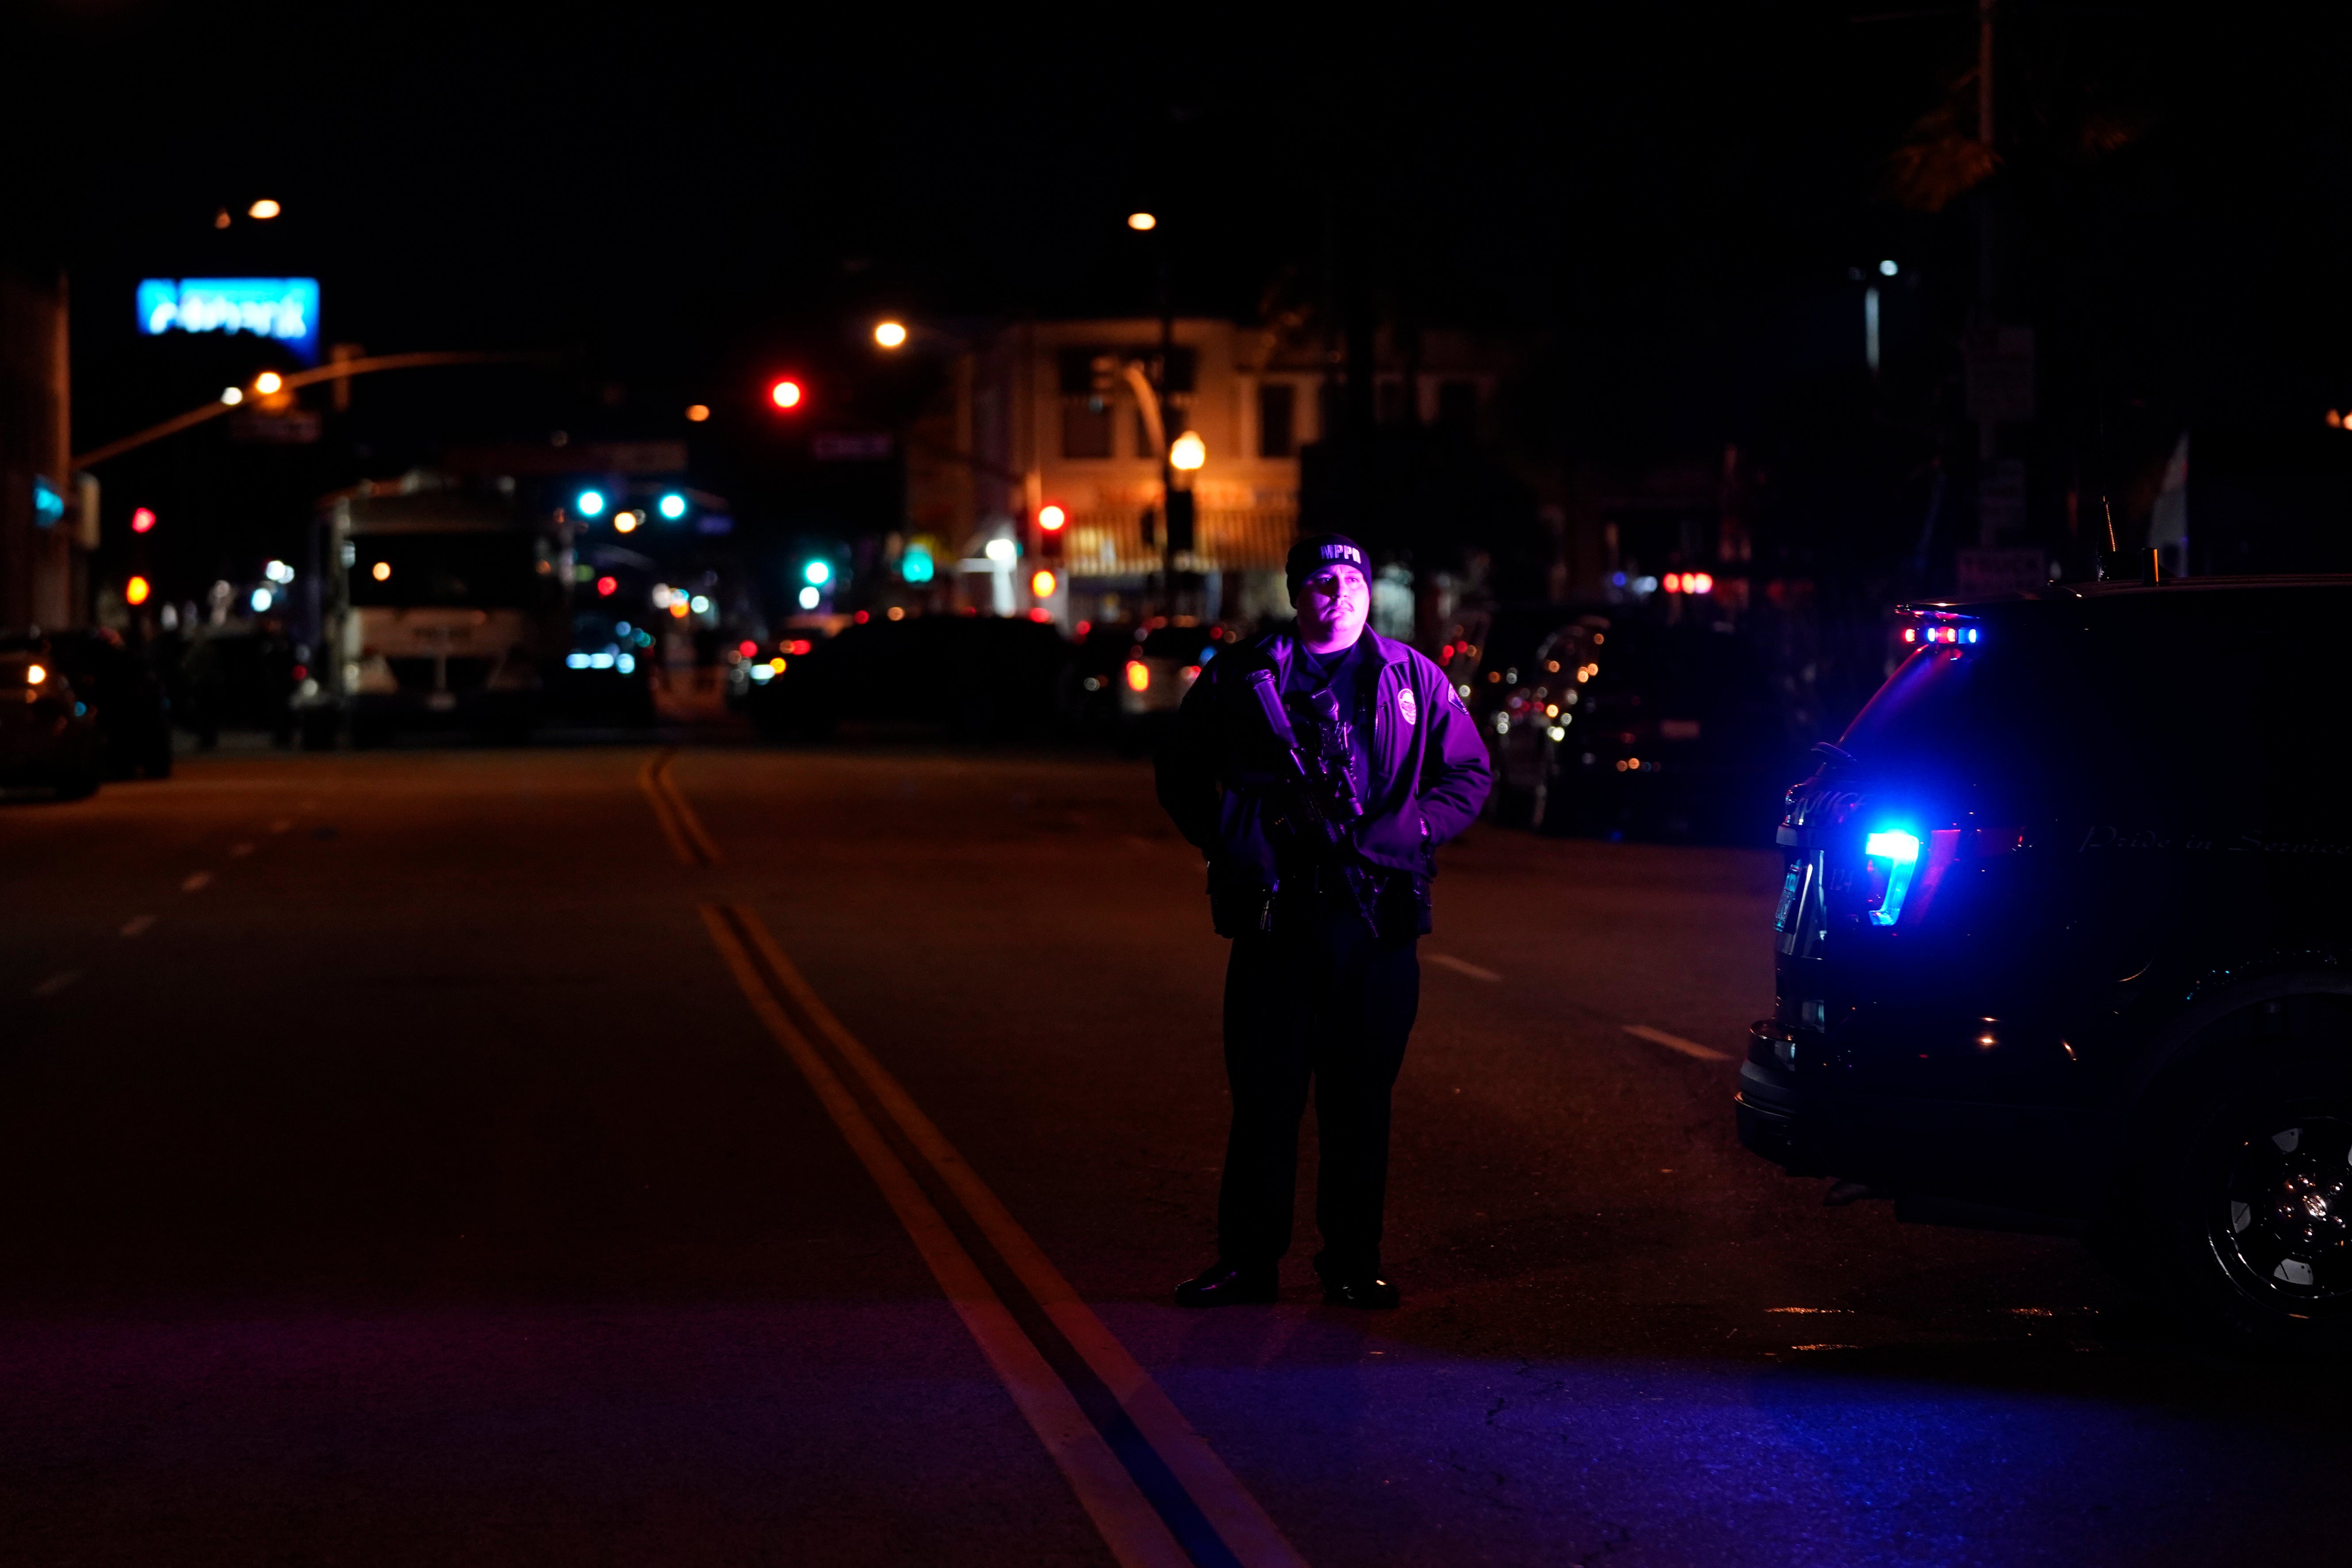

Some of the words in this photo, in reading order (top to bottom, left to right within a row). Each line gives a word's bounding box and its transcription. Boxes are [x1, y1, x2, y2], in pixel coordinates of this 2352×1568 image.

[1320, 545, 1361, 564] MPPD
[2078, 825, 2171, 853] Pride
[2185, 834, 2212, 850] in
